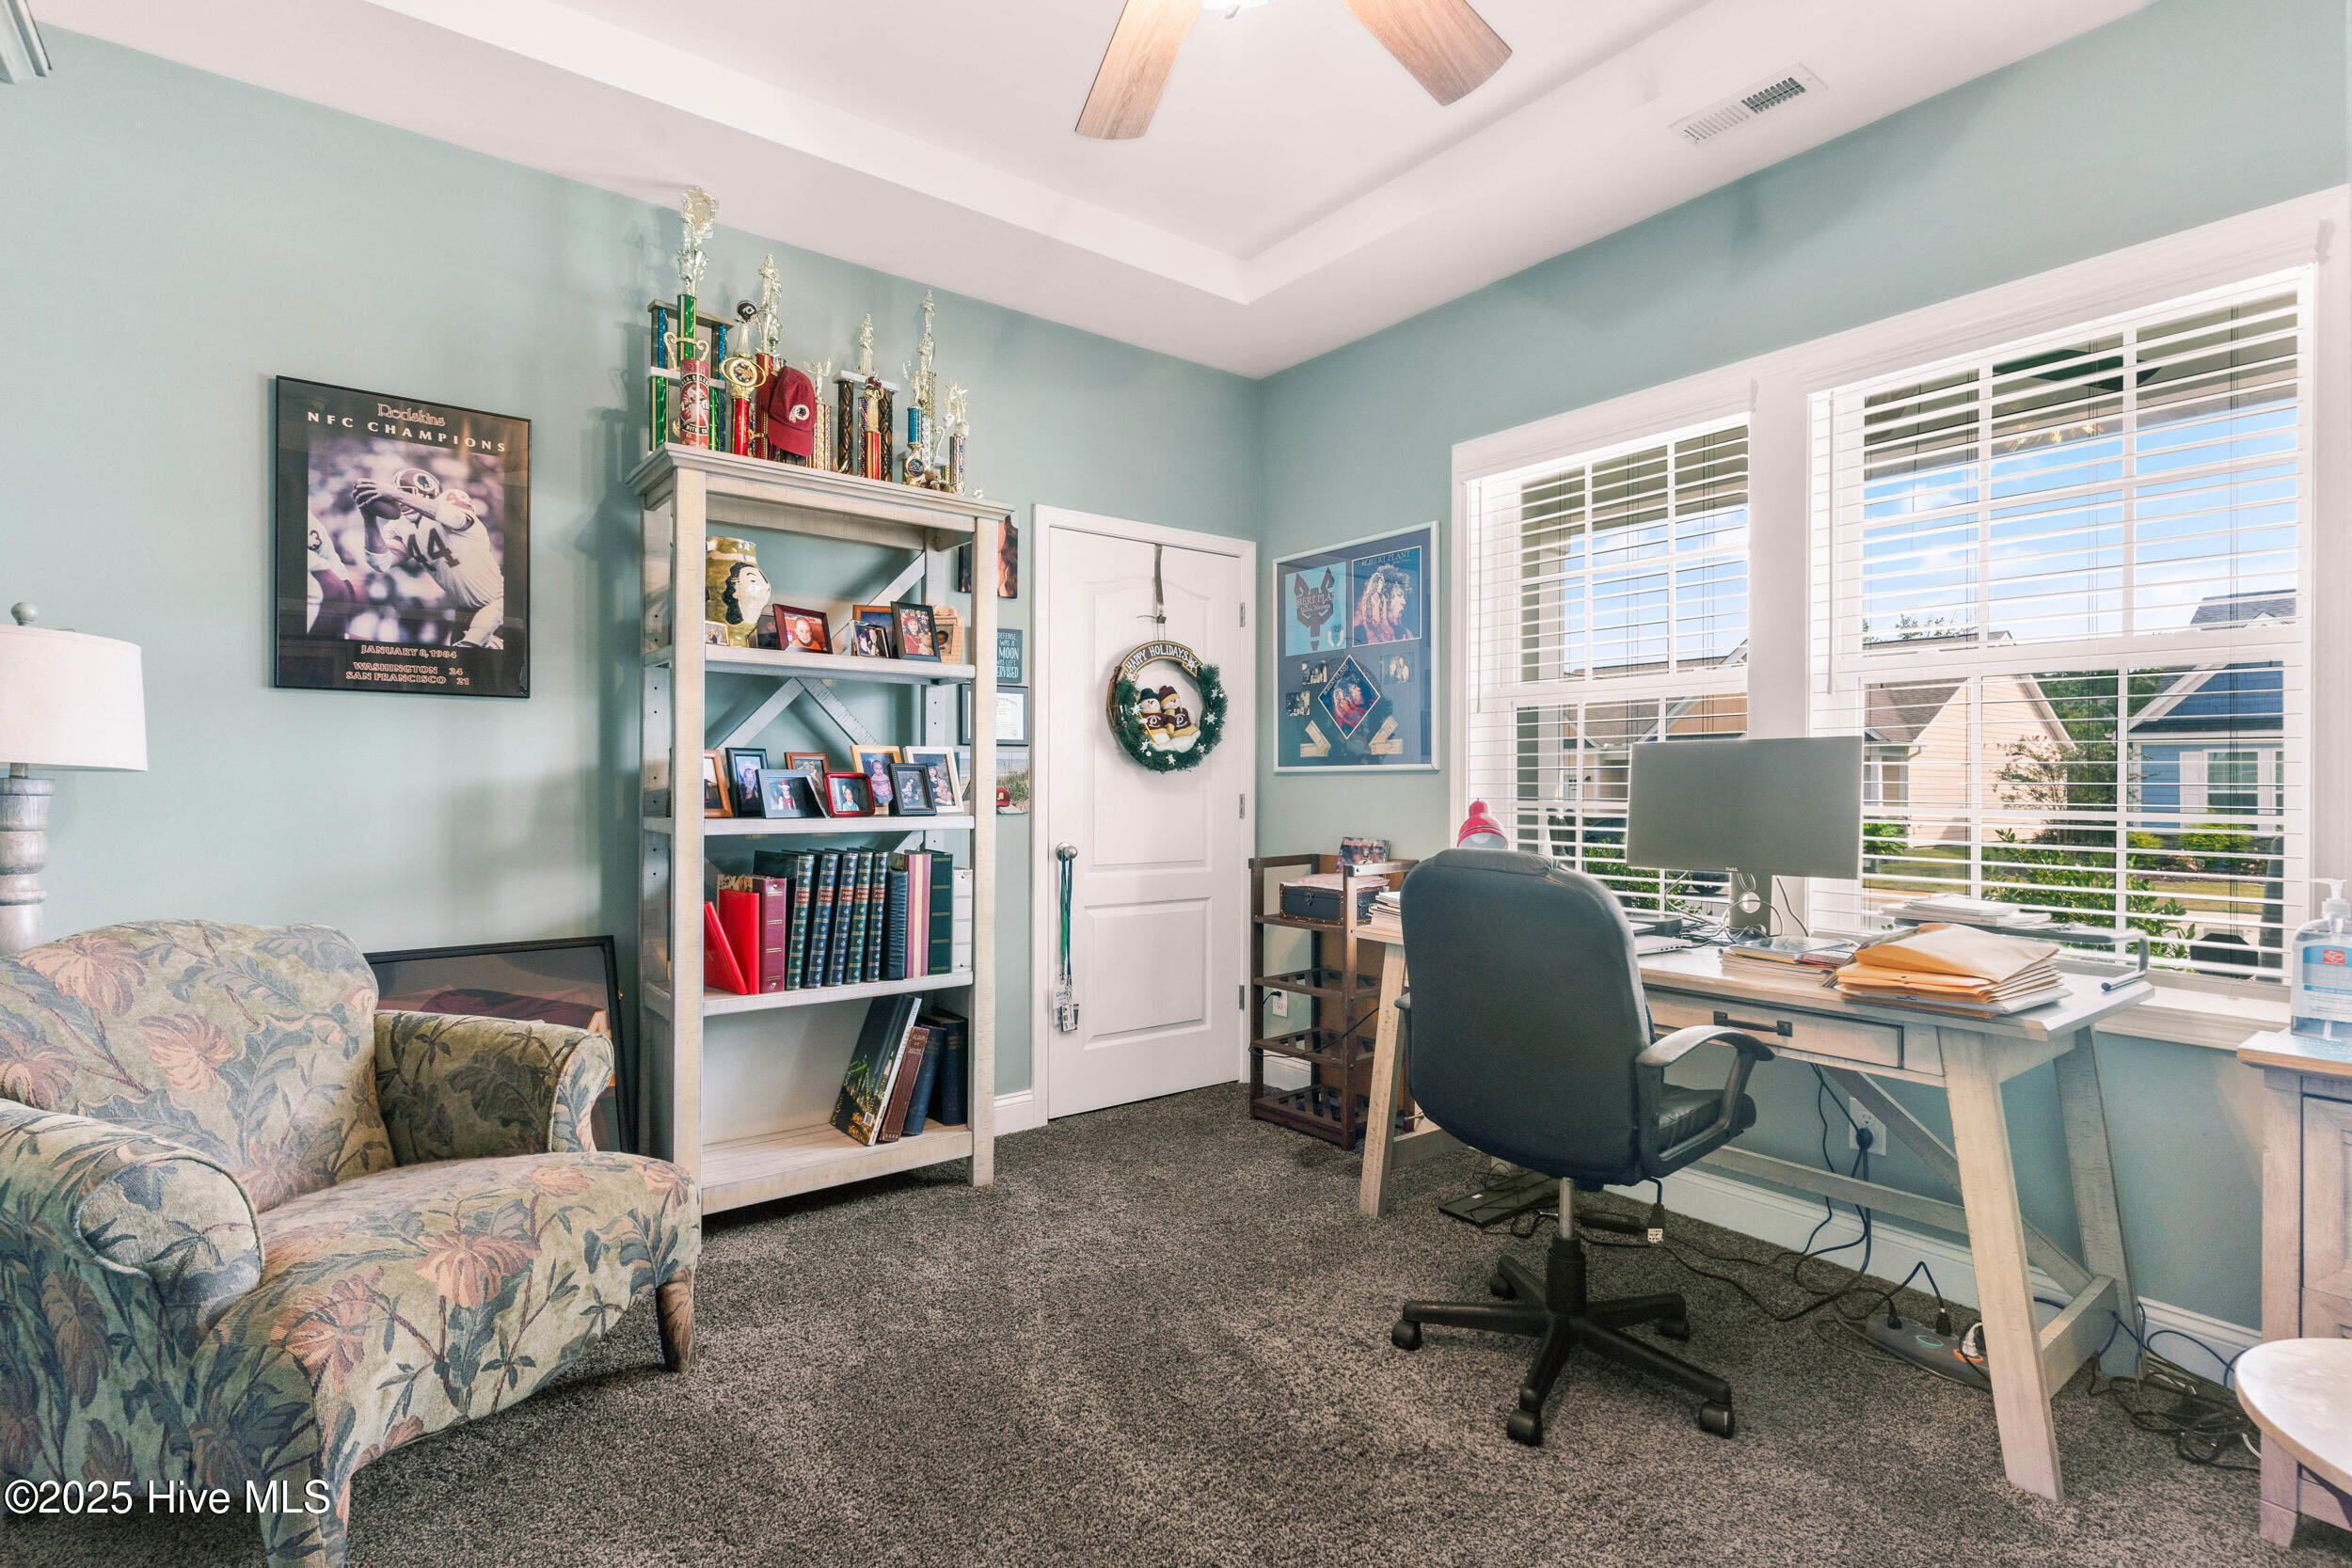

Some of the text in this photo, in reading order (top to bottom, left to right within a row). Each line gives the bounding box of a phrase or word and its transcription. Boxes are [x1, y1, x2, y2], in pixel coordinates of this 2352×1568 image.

[307, 411, 505, 452] NFC CHAMPIONS
[360, 644, 418, 657] JANUARY
[429, 649, 457, 658] 1984
[998, 646, 1020, 659] MOON
[1125, 644, 1189, 672] HAPPY HOLIDAYS
[353, 661, 464, 676] WASHINGTON 24
[345, 671, 469, 686] SAN FRANCISCO 21
